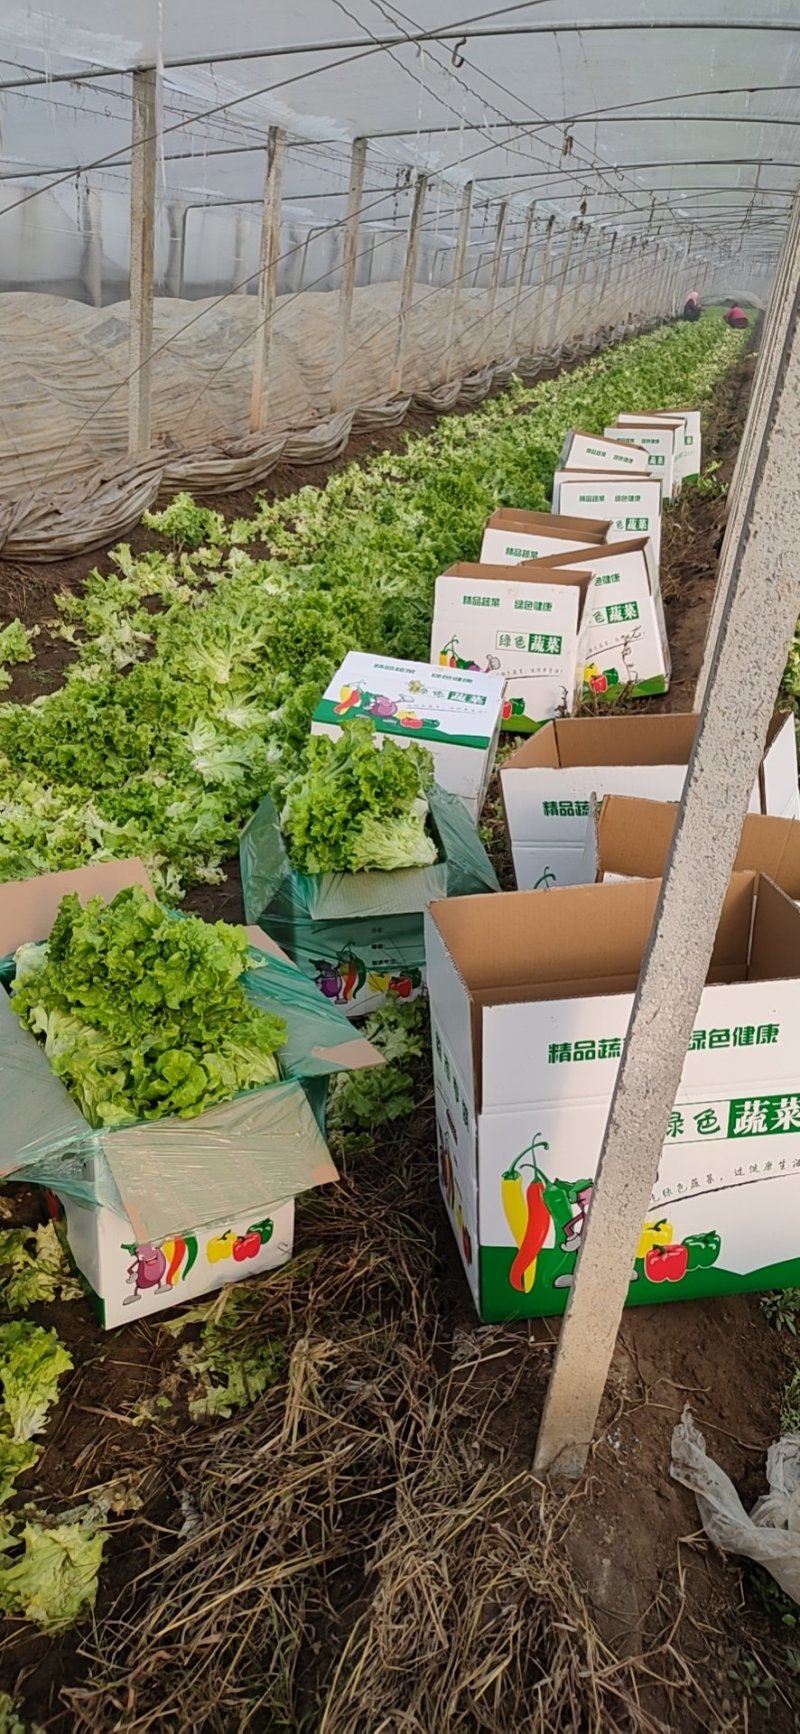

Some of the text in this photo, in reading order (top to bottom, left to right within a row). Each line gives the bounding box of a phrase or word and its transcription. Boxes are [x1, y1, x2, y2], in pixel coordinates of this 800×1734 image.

[589, 602, 639, 624] 色蔬菜
[542, 800, 603, 816] 精品蔬
[548, 1037, 629, 1064] 精品蔬
